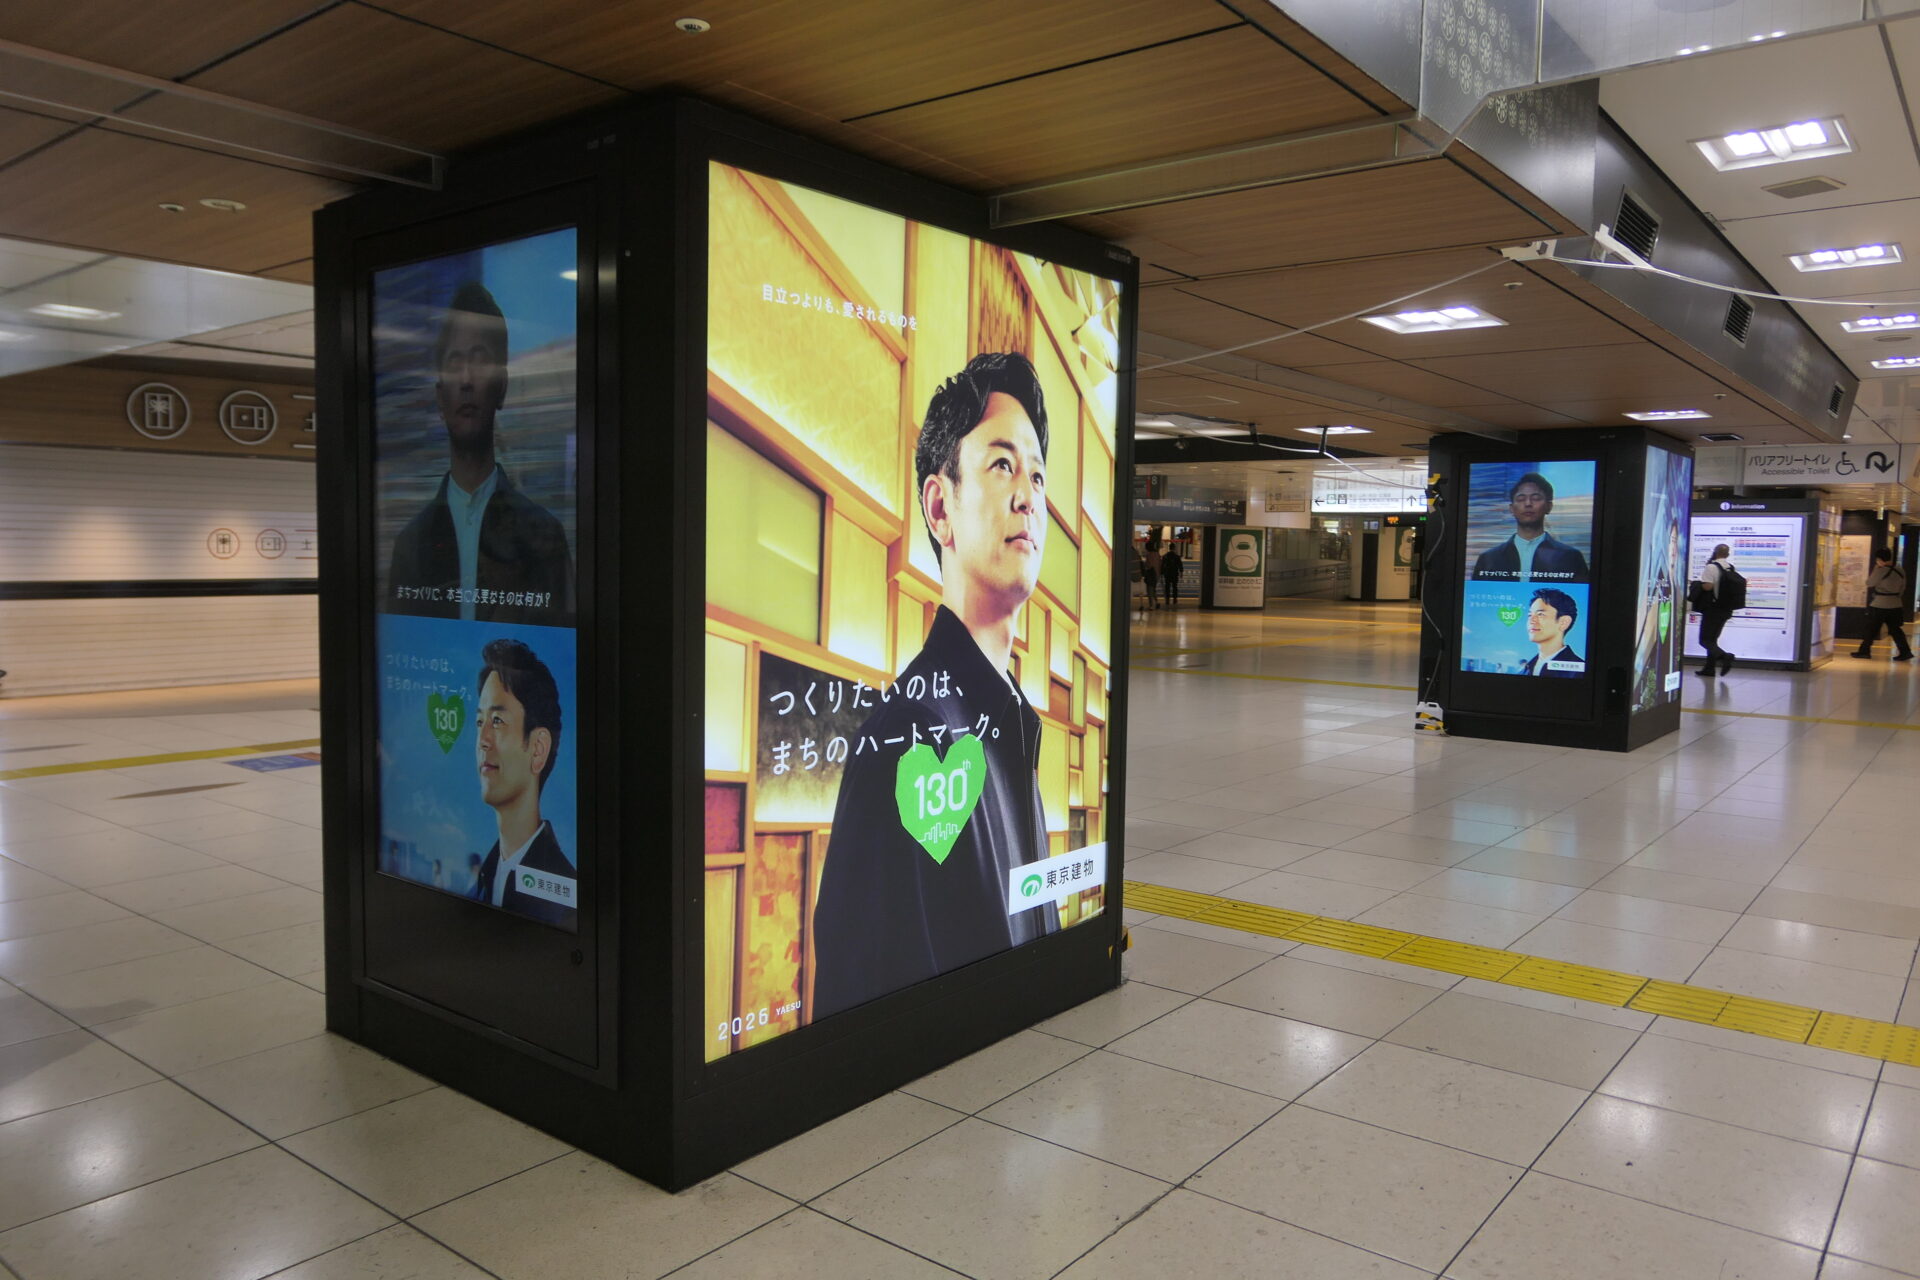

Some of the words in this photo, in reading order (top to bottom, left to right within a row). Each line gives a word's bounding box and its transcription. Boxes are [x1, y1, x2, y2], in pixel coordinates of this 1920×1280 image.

[762, 283, 918, 331] 目立つよりも、愛されるものを
[1748, 454, 1832, 467] バリアフリートイレ
[1761, 467, 1805, 476] Accessible
[1807, 467, 1831, 475] Toilet
[770, 670, 964, 716] つくりたいのは、
[772, 713, 1000, 776] まちのハートマーク。
[1046, 858, 1095, 889] 東京建物
[718, 1007, 769, 1041] 2026
[775, 1000, 801, 1016] YAESU
